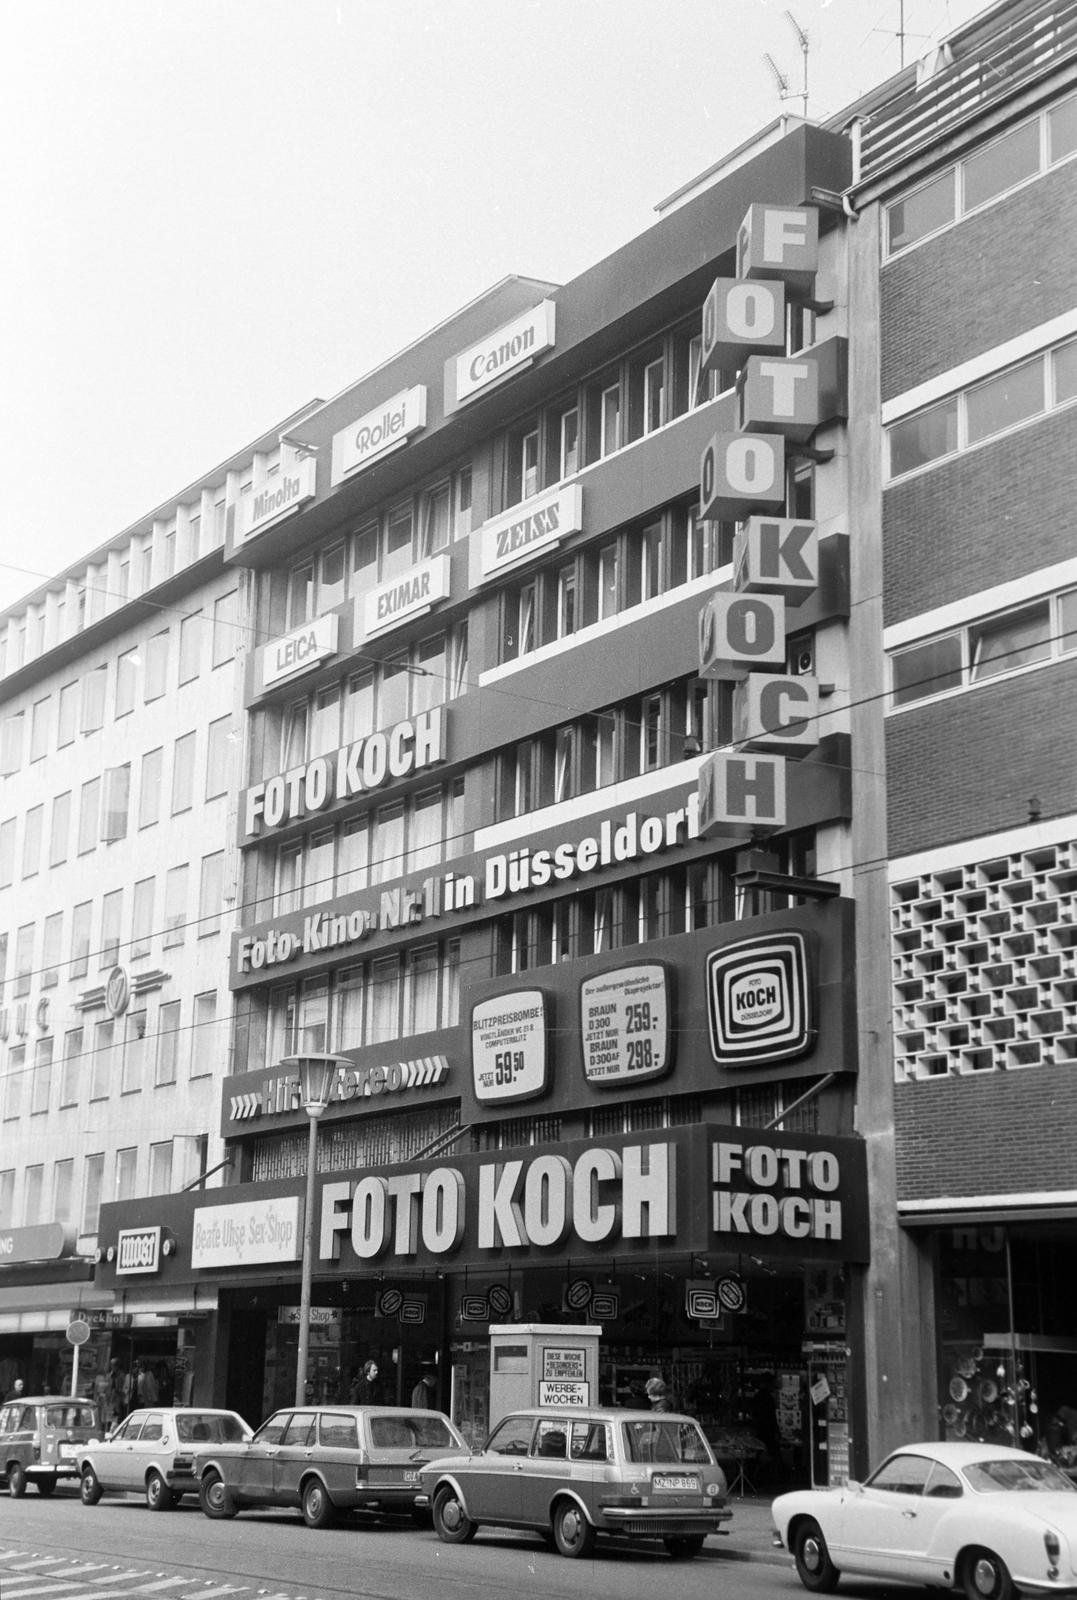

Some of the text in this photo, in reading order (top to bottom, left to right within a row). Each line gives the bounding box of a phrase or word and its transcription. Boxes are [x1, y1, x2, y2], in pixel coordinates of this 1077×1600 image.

[470, 326, 535, 382] Canon
[356, 402, 406, 453] Rollei
[253, 476, 300, 523] Minolta
[726, 212, 815, 818] FOTO KOCH
[496, 502, 560, 559] ZEISS
[377, 571, 431, 620] EXIMAR
[277, 631, 318, 672] LEICA
[245, 706, 444, 835] FOTO KOCH
[445, 872, 475, 911] in
[486, 791, 700, 899] Düsseldorf
[588, 1003, 617, 1018] BRAUN
[736, 985, 776, 1010] KOCH
[585, 1028, 619, 1042] JETZT NUR
[589, 1039, 618, 1053] BRAUN
[478, 1072, 494, 1081] JETZT
[586, 1064, 620, 1077] JETZT NUR
[712, 1141, 840, 1193] FOTO
[319, 1142, 674, 1259] FOTO KOCH
[712, 1190, 842, 1241] KOCH
[195, 1222, 221, 1250] Beate
[223, 1218, 245, 1248] Uhse
[544, 1394, 584, 1405] WOCHEN
[546, 1383, 581, 1393] WERBE-
